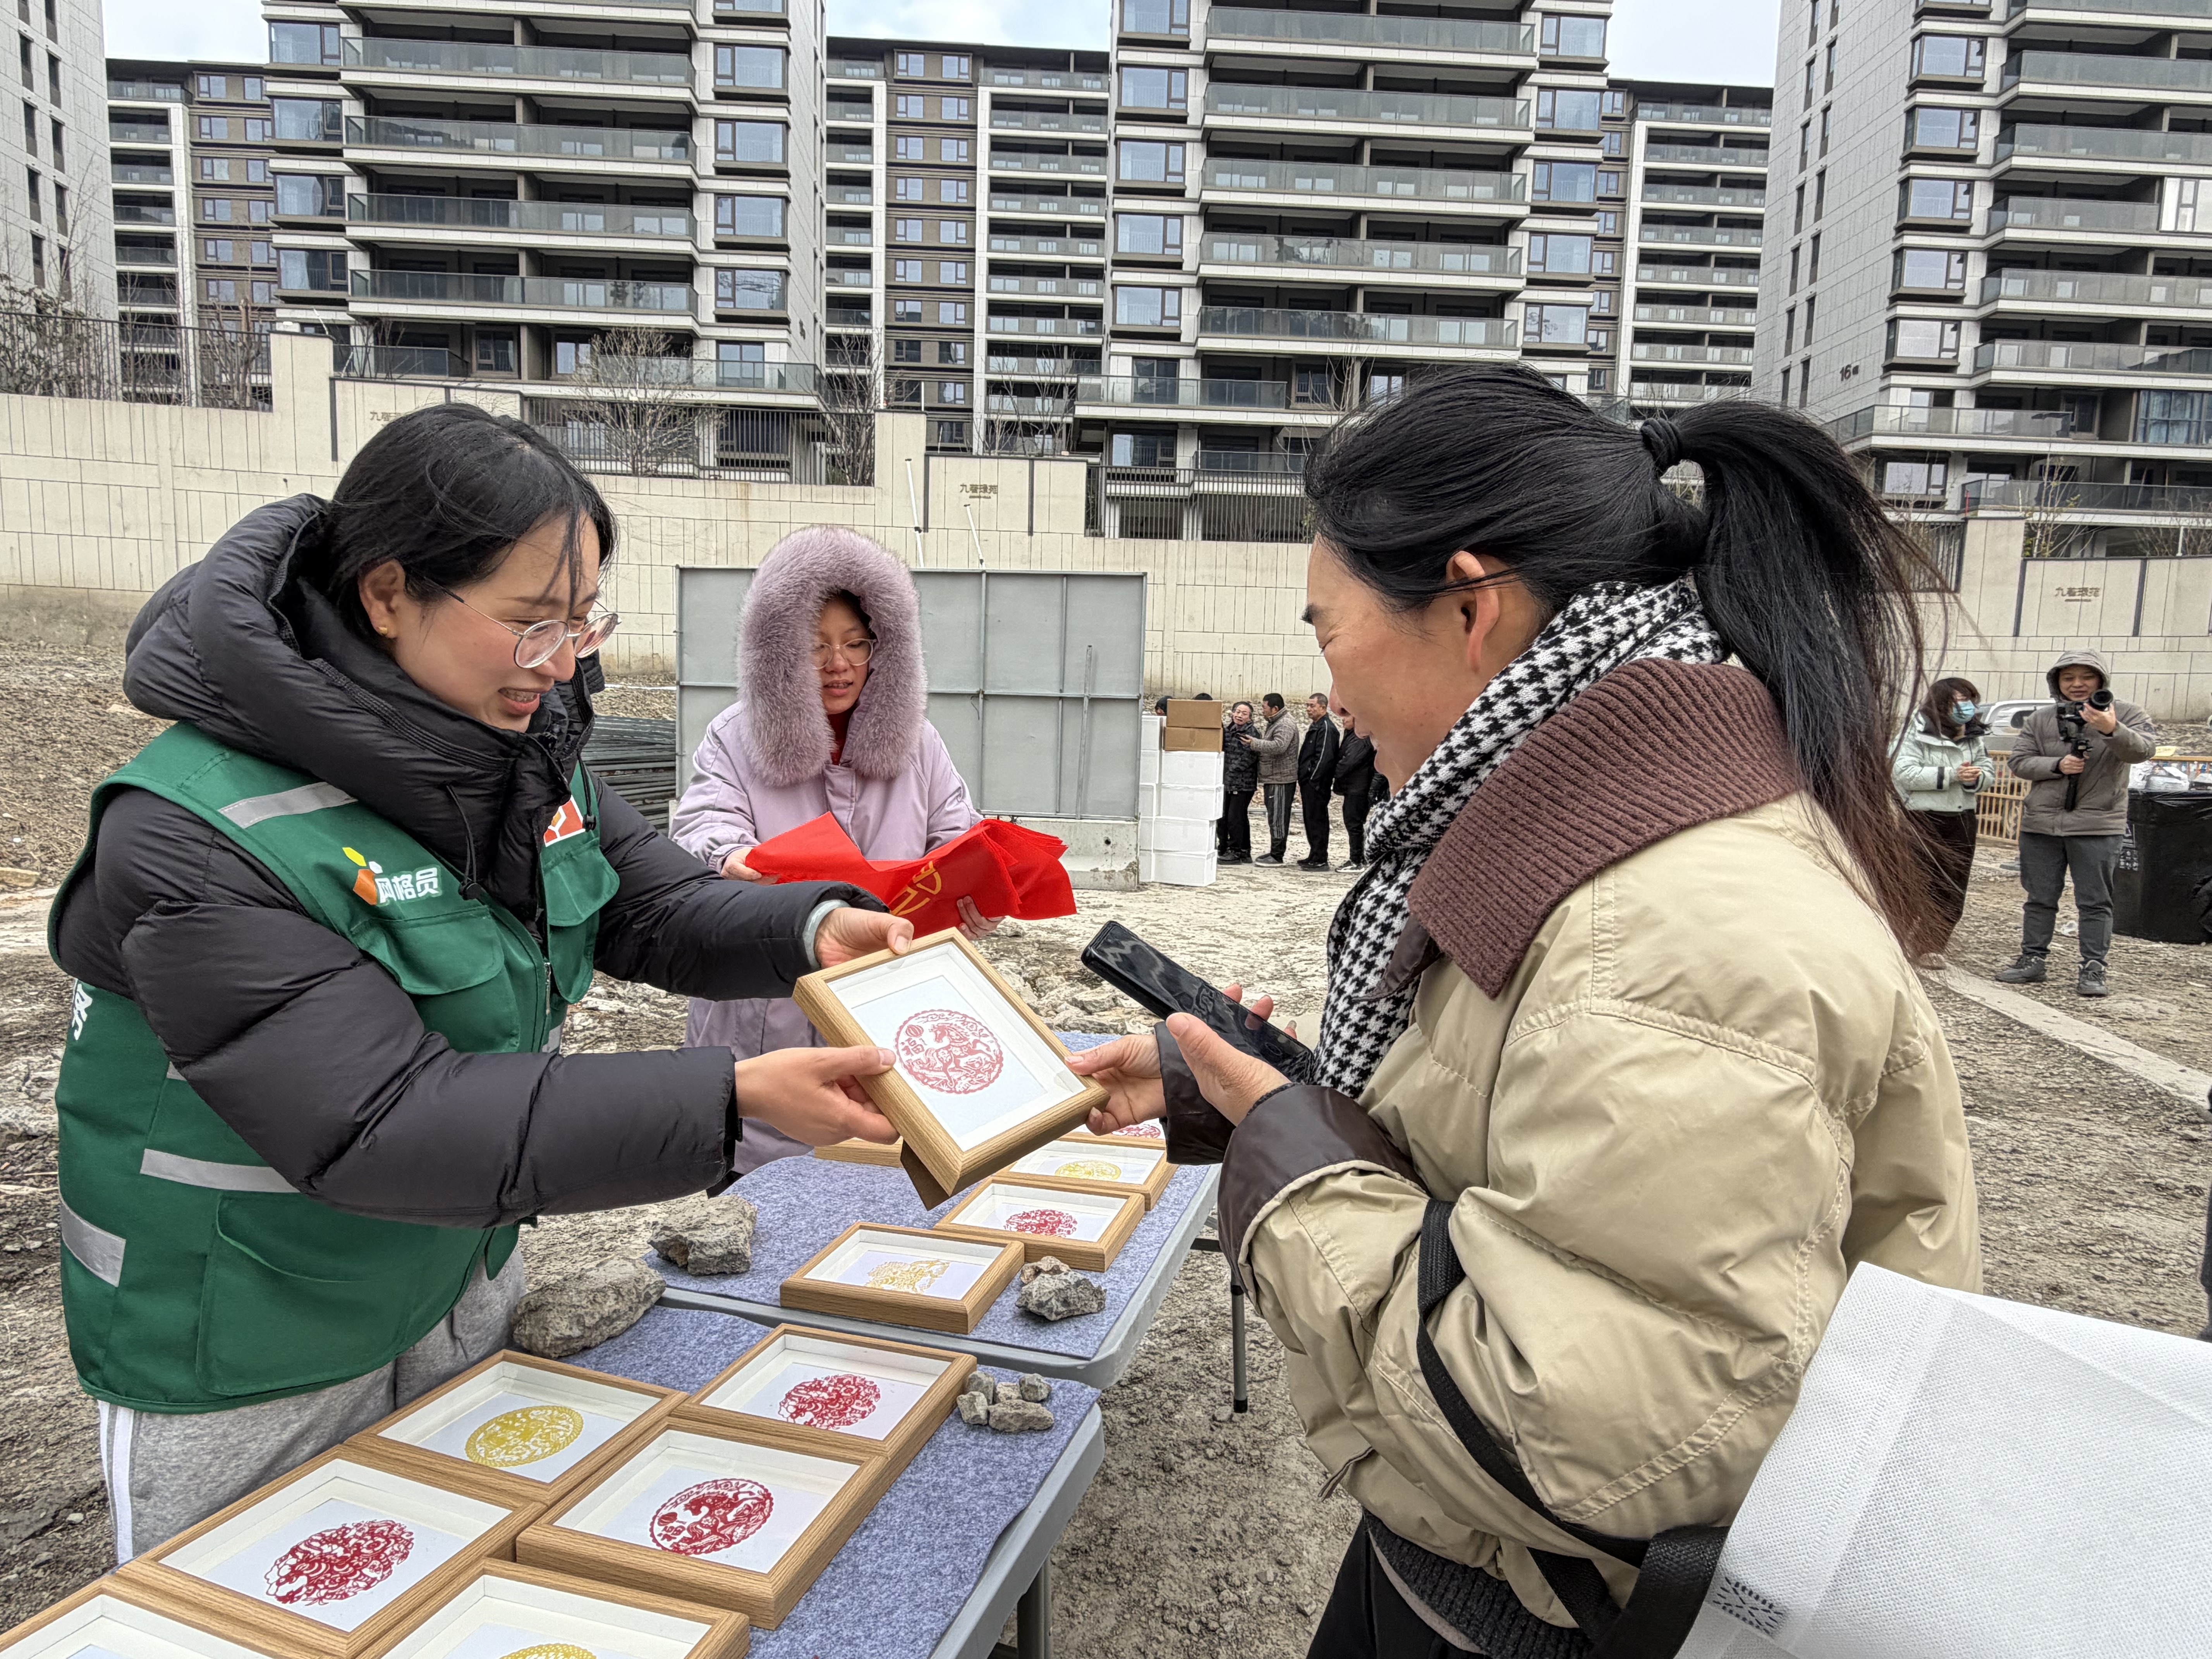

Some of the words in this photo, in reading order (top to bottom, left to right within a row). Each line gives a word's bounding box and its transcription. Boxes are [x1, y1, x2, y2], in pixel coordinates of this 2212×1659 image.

[1840, 364, 1859, 381] 16
[374, 867, 439, 903] 网格员
